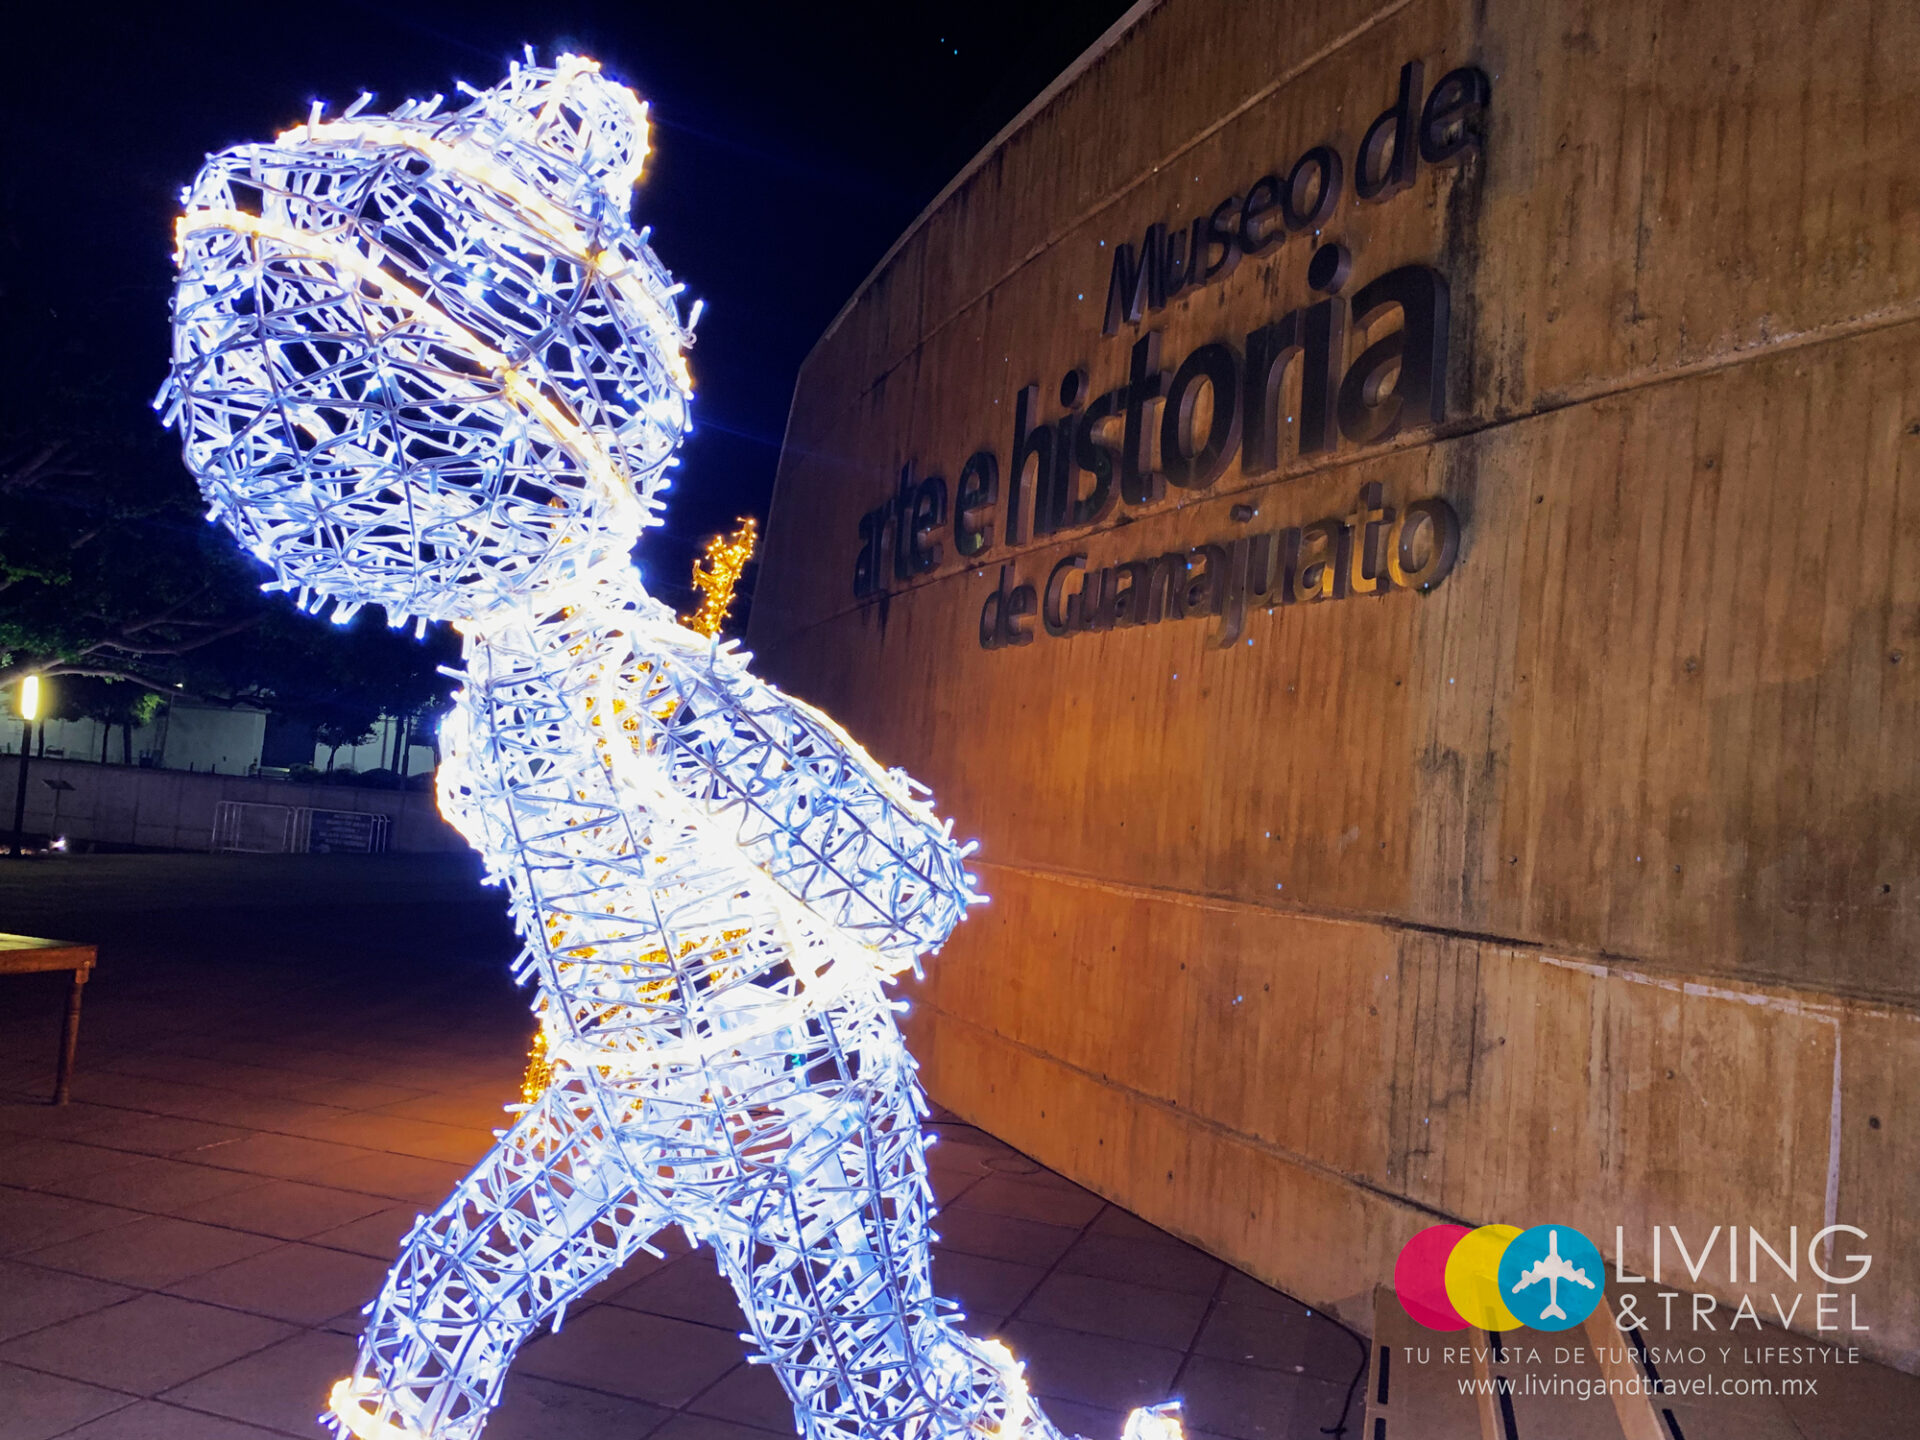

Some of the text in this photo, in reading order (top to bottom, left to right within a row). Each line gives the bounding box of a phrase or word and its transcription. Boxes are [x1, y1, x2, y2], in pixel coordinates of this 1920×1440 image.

[1103, 60, 1491, 338] Museo de
[853, 242, 1451, 599] arte e historia
[979, 481, 1461, 650] de Guanajuato
